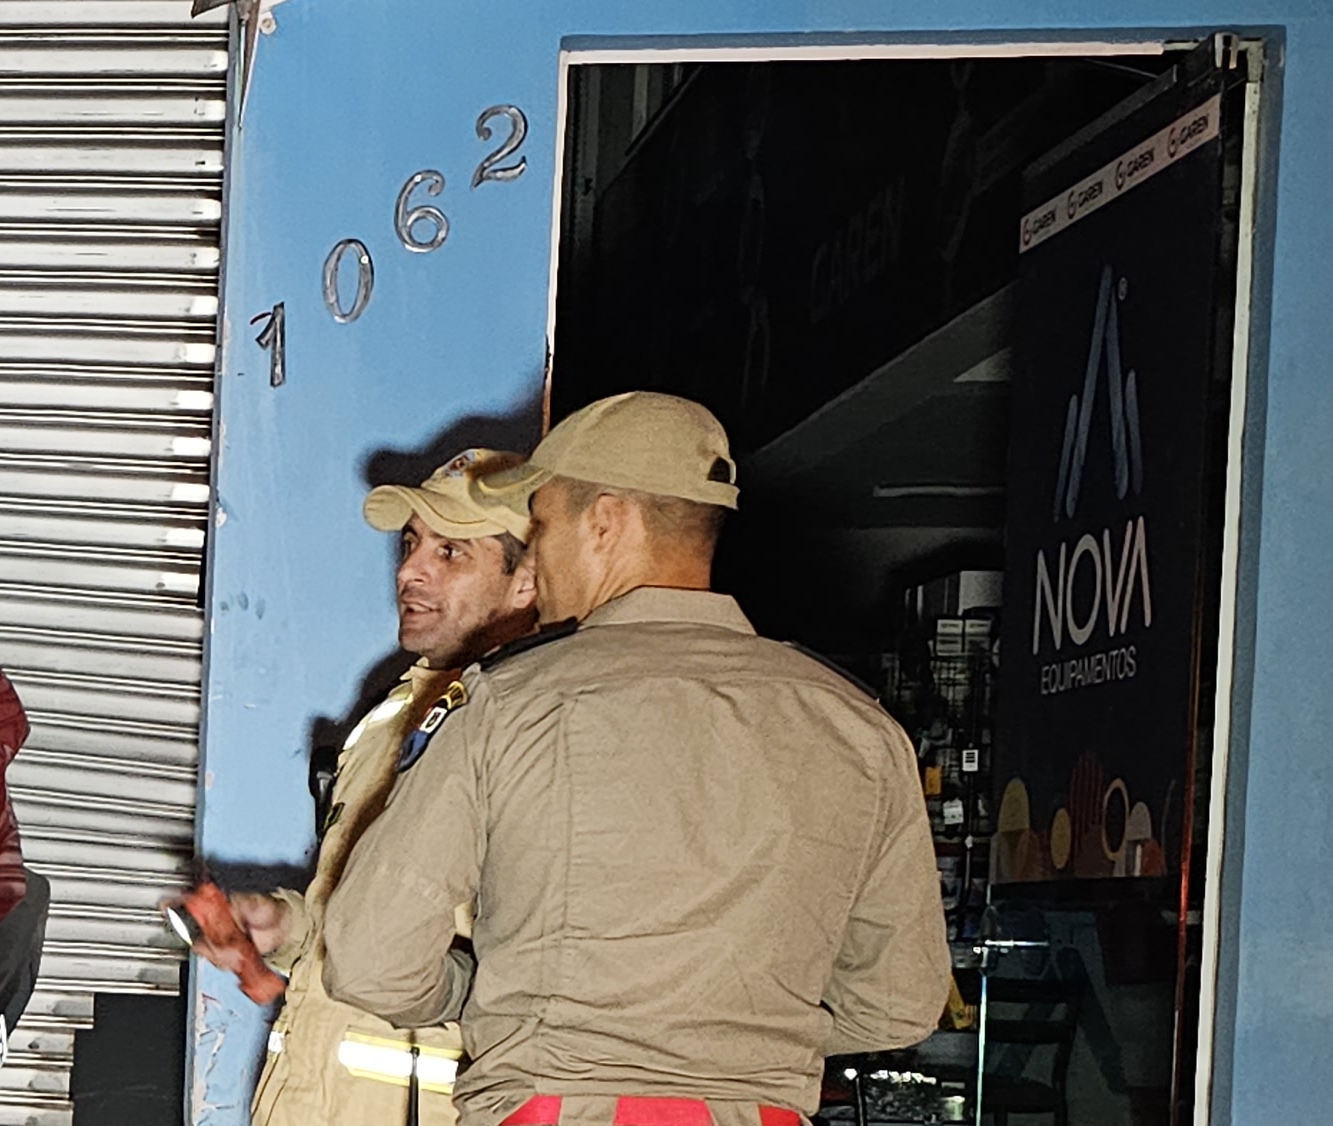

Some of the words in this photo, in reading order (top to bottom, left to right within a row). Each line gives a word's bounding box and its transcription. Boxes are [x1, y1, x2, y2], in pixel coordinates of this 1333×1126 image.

[250, 104, 528, 388] 1062
[1032, 515, 1152, 656] NOVA
[1040, 645, 1137, 694] EQUIPAMENTOS
